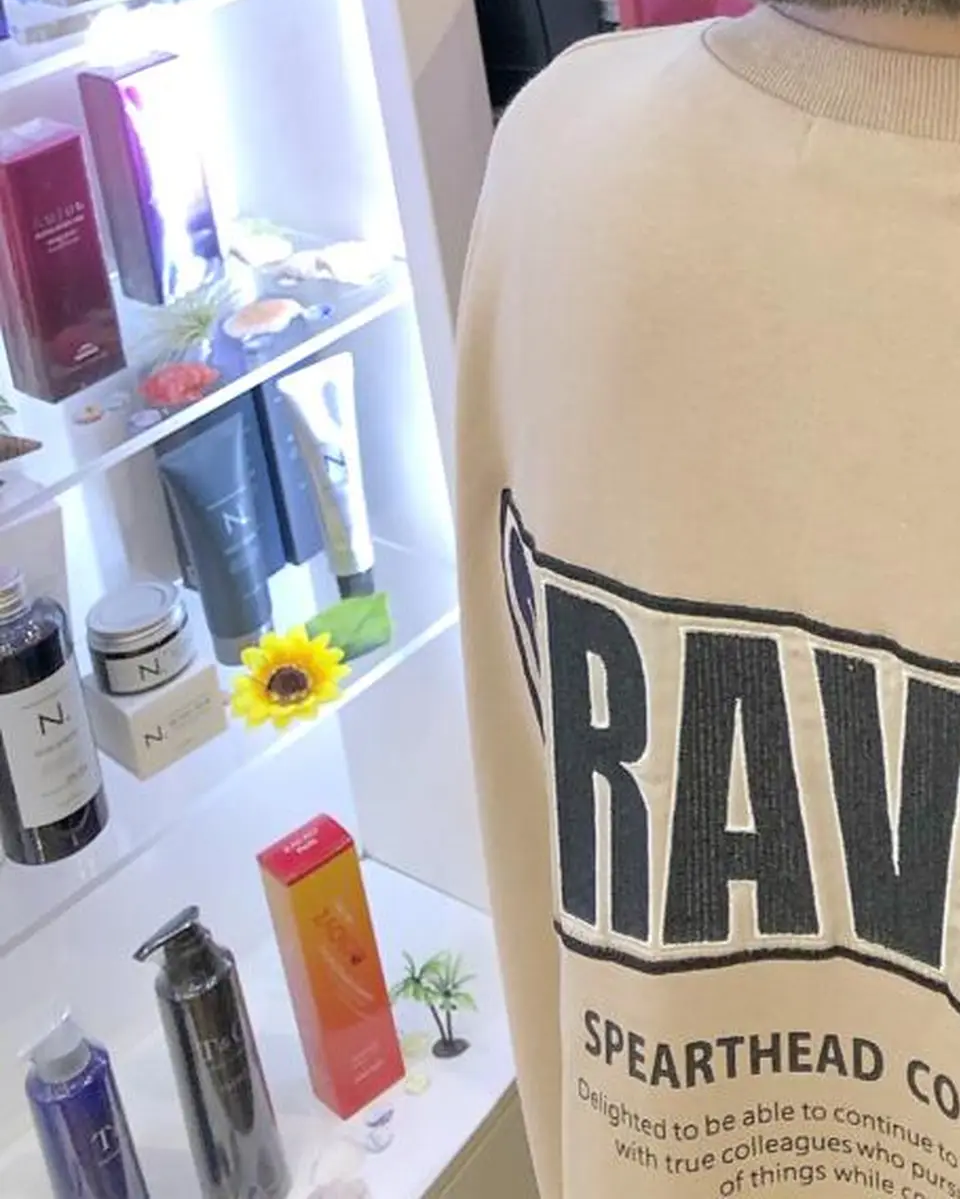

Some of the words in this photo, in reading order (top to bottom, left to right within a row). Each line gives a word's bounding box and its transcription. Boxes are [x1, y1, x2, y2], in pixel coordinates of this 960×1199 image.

[584, 1009, 884, 1090] SPEARTHEAD
[577, 1077, 667, 1140] Delighted
[673, 1122, 699, 1141] to
[705, 1114, 736, 1137] be
[742, 1102, 795, 1127] able
[801, 1103, 828, 1121] to
[833, 1107, 933, 1153] continue
[938, 1143, 958, 1169] to
[614, 1139, 658, 1170] with
[665, 1152, 716, 1174] true
[721, 1135, 853, 1164] colleagues
[856, 1142, 905, 1169] who
[719, 1170, 744, 1196] of
[751, 1163, 827, 1188] things
[833, 1165, 895, 1194] while
